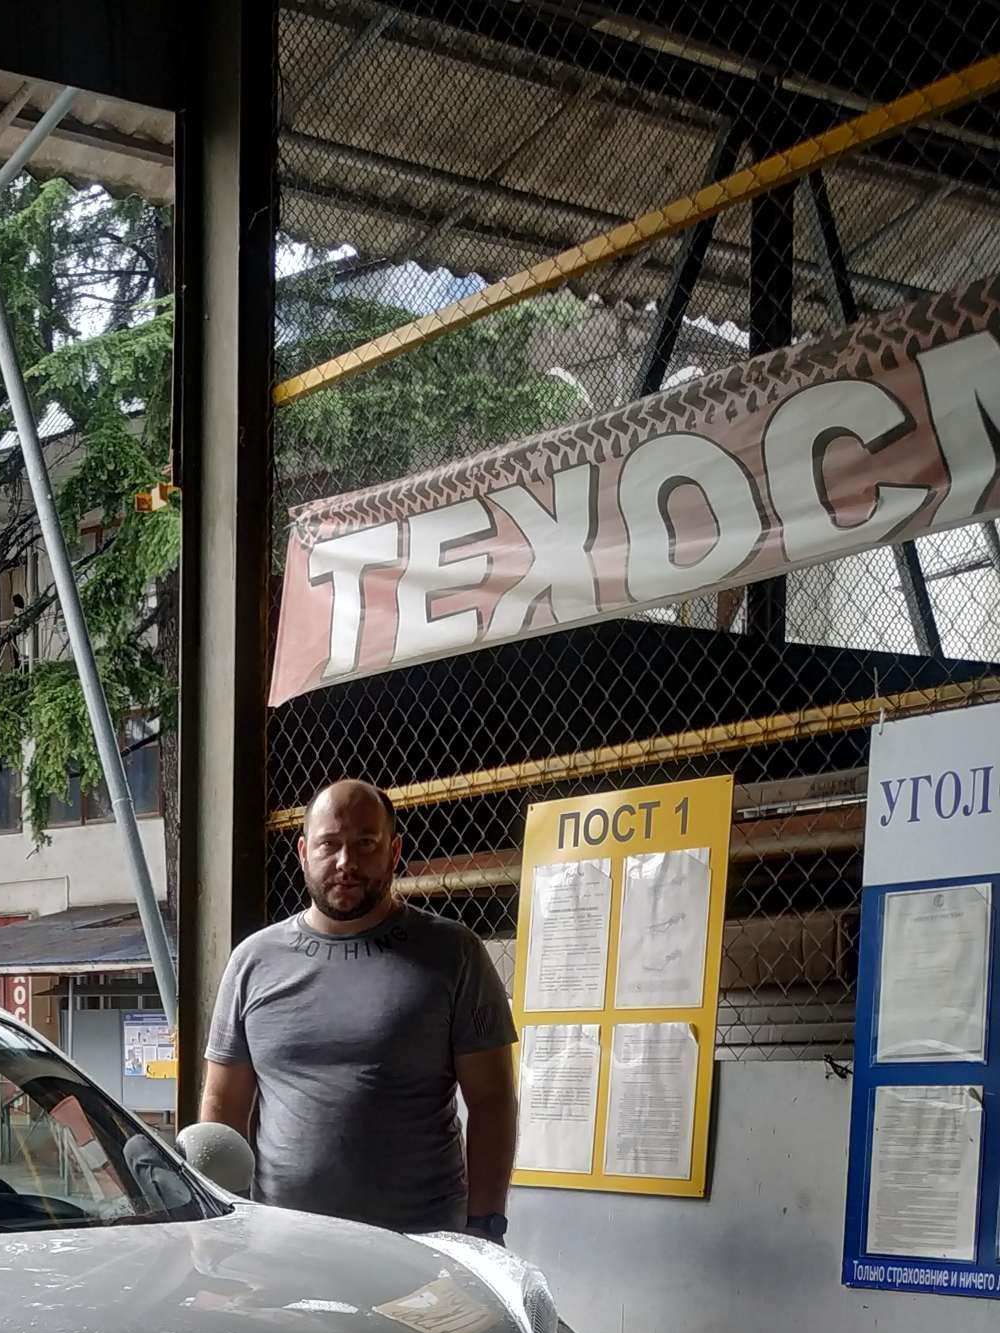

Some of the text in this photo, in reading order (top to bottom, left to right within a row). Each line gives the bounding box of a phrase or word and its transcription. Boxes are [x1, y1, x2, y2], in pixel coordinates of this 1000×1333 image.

[880, 766, 1000, 827] УГОЛ
[558, 797, 689, 849] ПОСТ 1
[853, 1260, 885, 1282] Только
[887, 1265, 949, 1287] страхование
[950, 1272, 957, 1286] и
[959, 1273, 995, 1291] ничего
